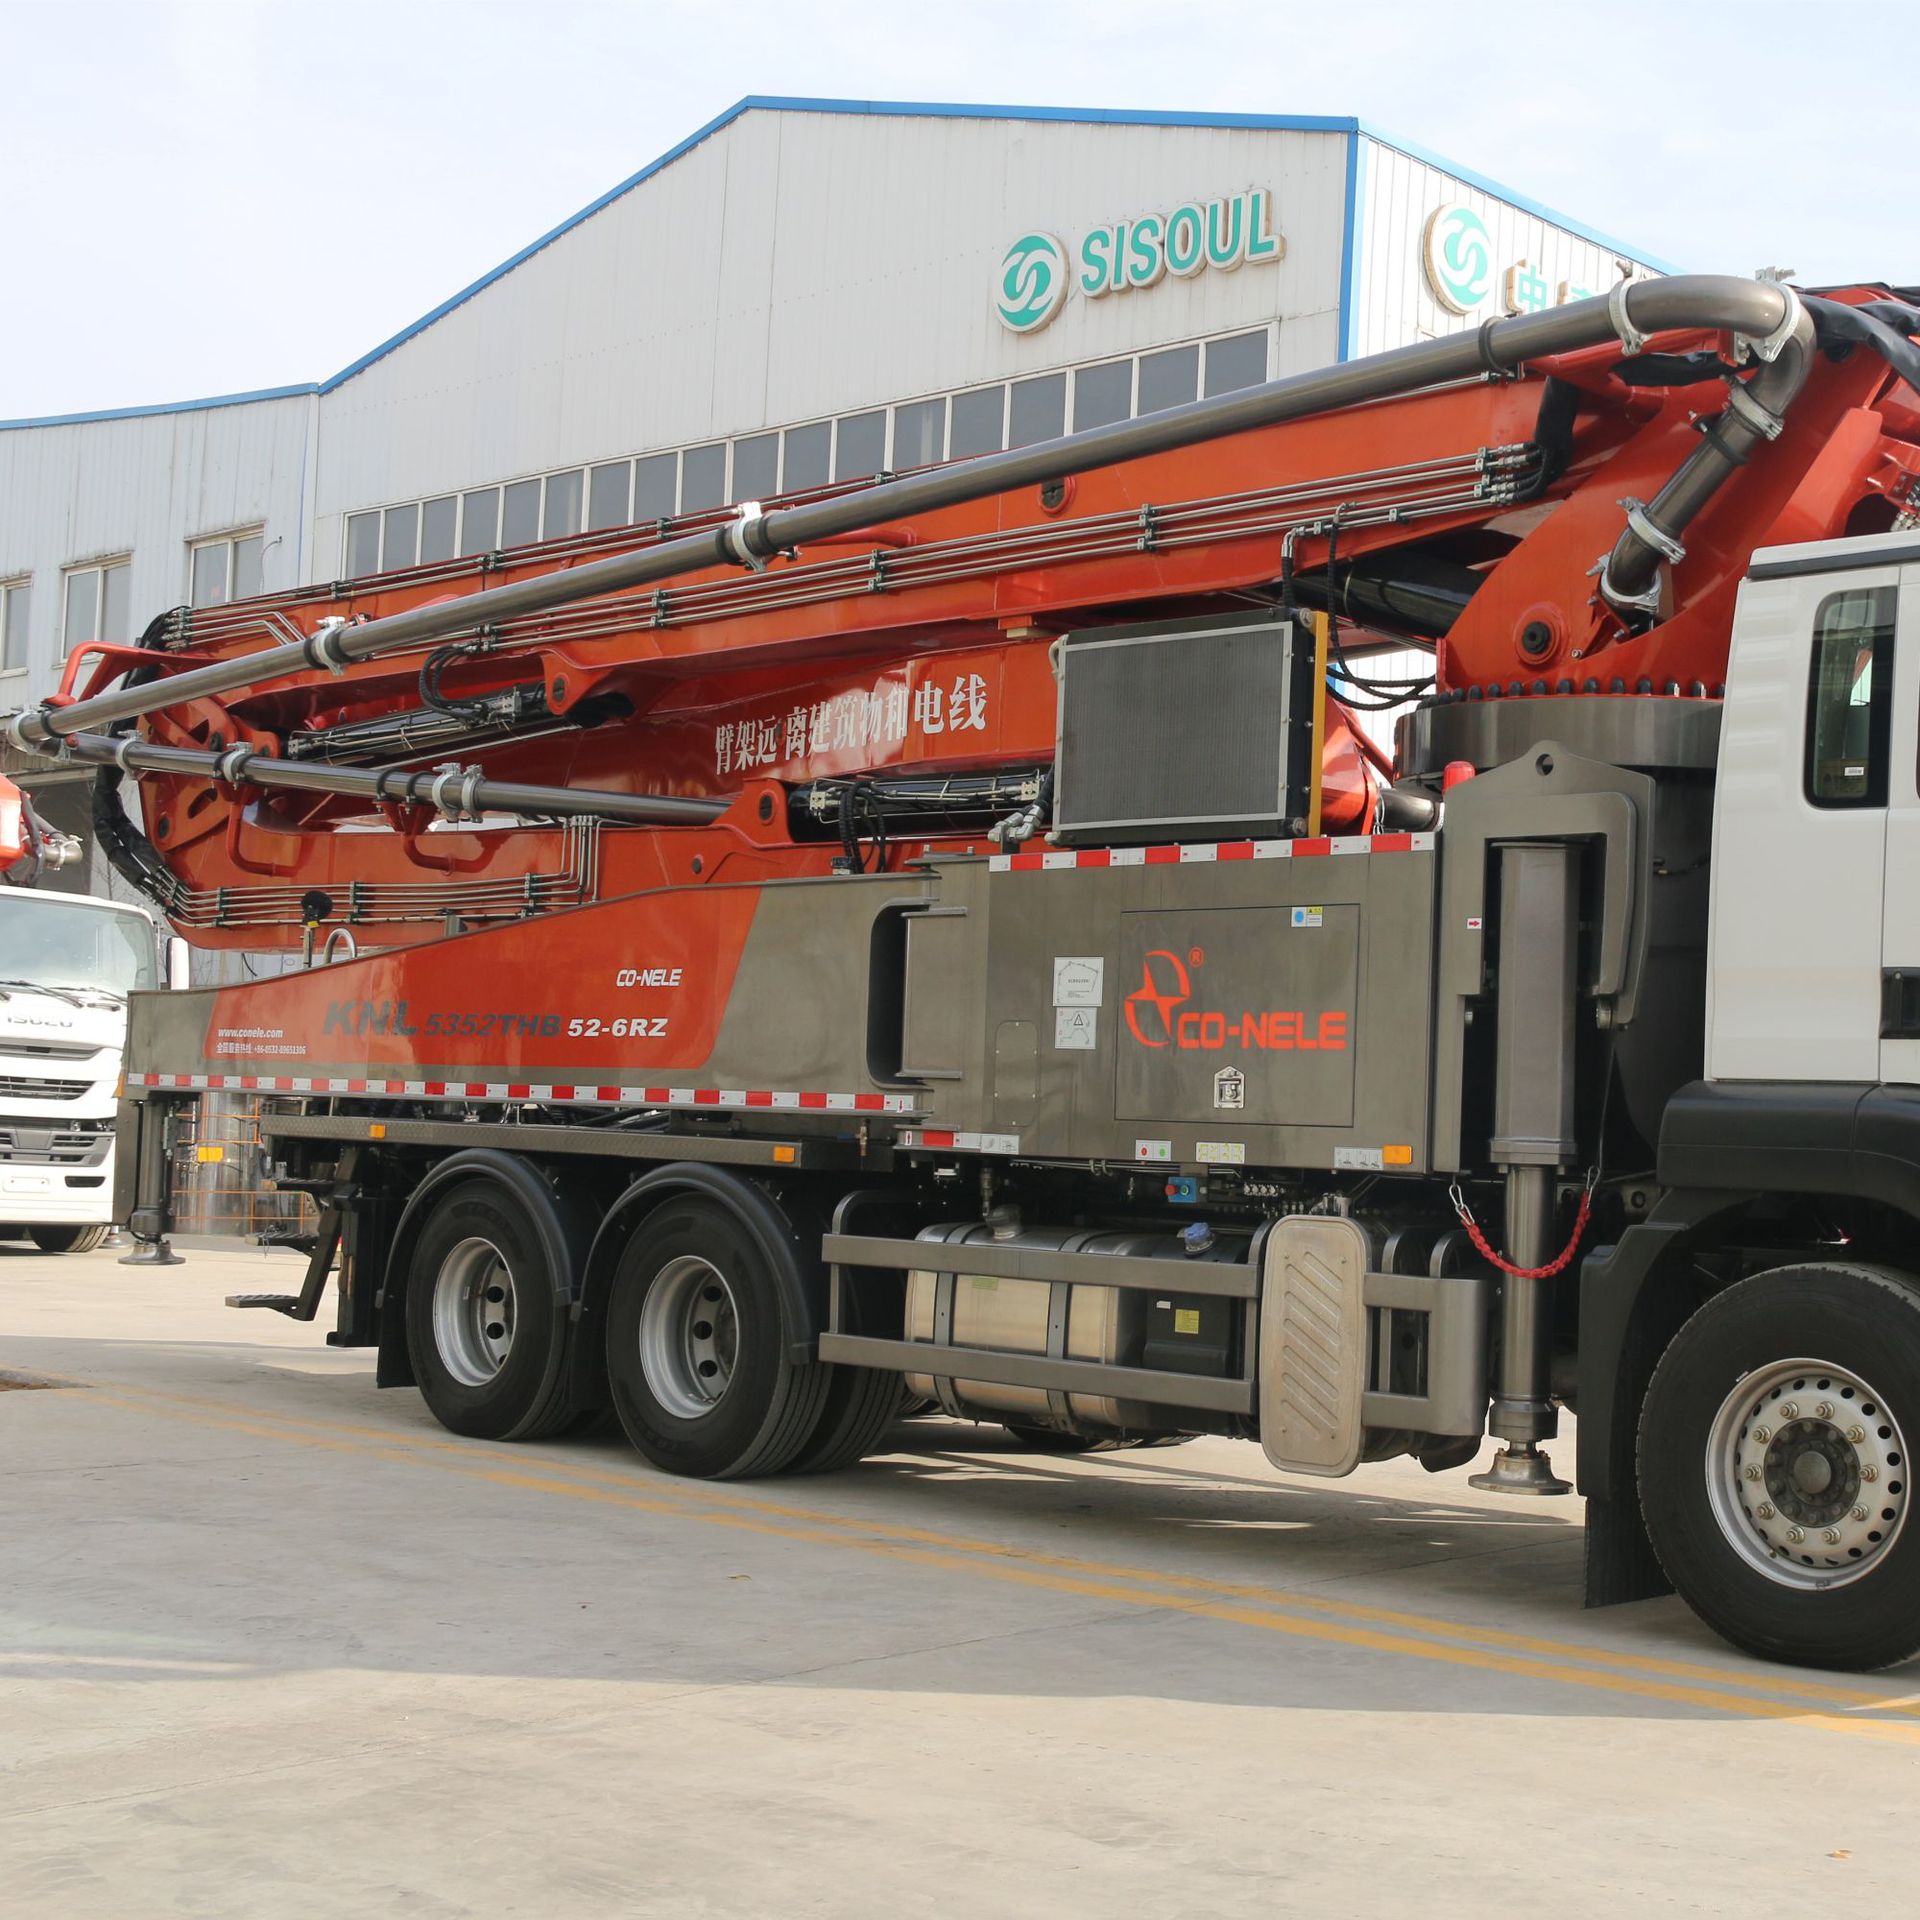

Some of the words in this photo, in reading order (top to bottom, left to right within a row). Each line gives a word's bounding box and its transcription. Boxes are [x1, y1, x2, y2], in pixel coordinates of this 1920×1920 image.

[1080, 191, 1278, 294] SISOUL
[714, 673, 987, 775] 臂架远离建筑物和电线
[616, 968, 683, 987] CO-NELE
[218, 1027, 284, 1038] www.conele.com
[322, 1000, 417, 1035] KNL
[424, 1013, 563, 1037] 5352THB
[567, 1018, 669, 1037] 52-6RZ
[1177, 1011, 1347, 1049] CO-NELE
